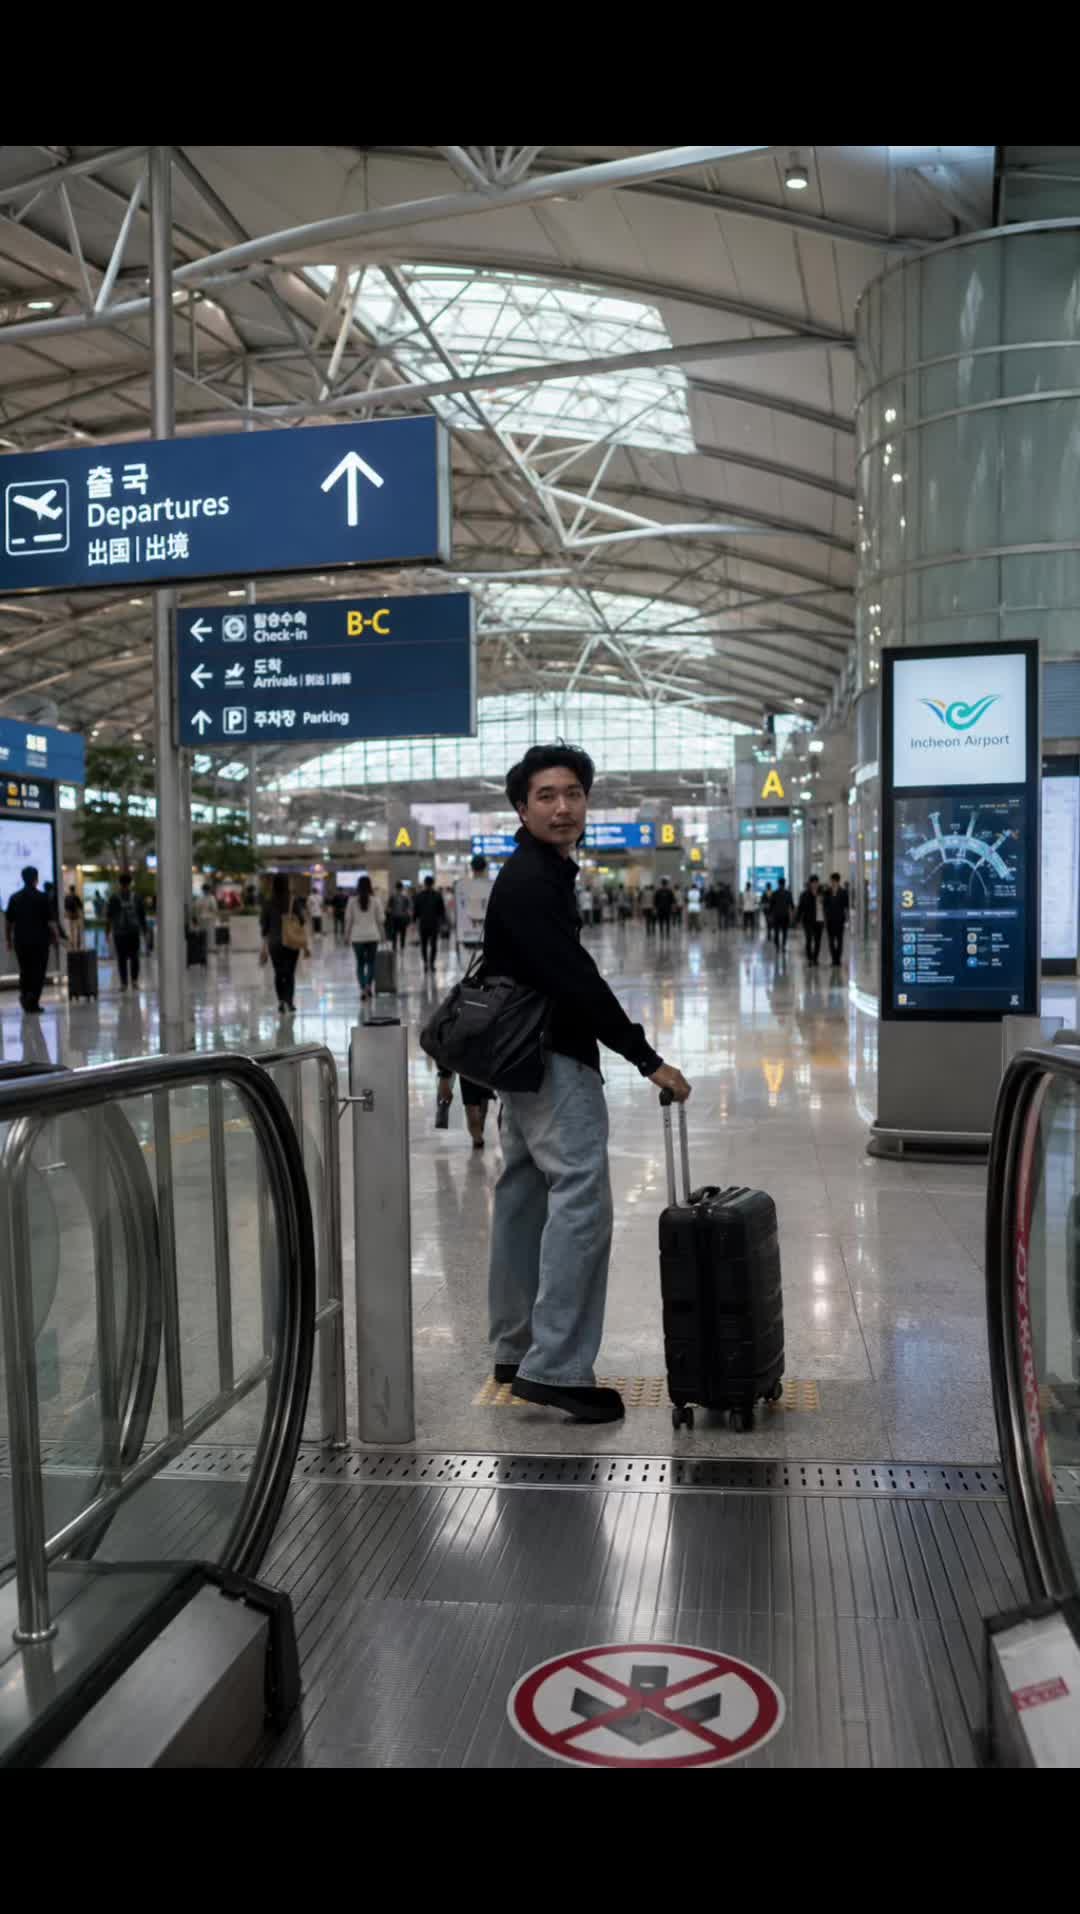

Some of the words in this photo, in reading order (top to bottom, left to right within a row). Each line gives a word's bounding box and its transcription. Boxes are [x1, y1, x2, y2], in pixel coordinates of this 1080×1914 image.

[88, 496, 230, 530] Departures
[88, 538, 130, 566] 出国
[146, 531, 189, 561] 出境
[347, 609, 390, 636] B-C
[253, 628, 308, 643] Check-in
[253, 674, 298, 688] Arrivals
[254, 710, 296, 728] 주차장
[303, 710, 350, 726] Parking
[910, 735, 961, 749] Incheon
[964, 734, 1010, 748] Airport
[761, 769, 785, 800] A
[395, 827, 411, 849] A
[901, 890, 914, 908] 3
